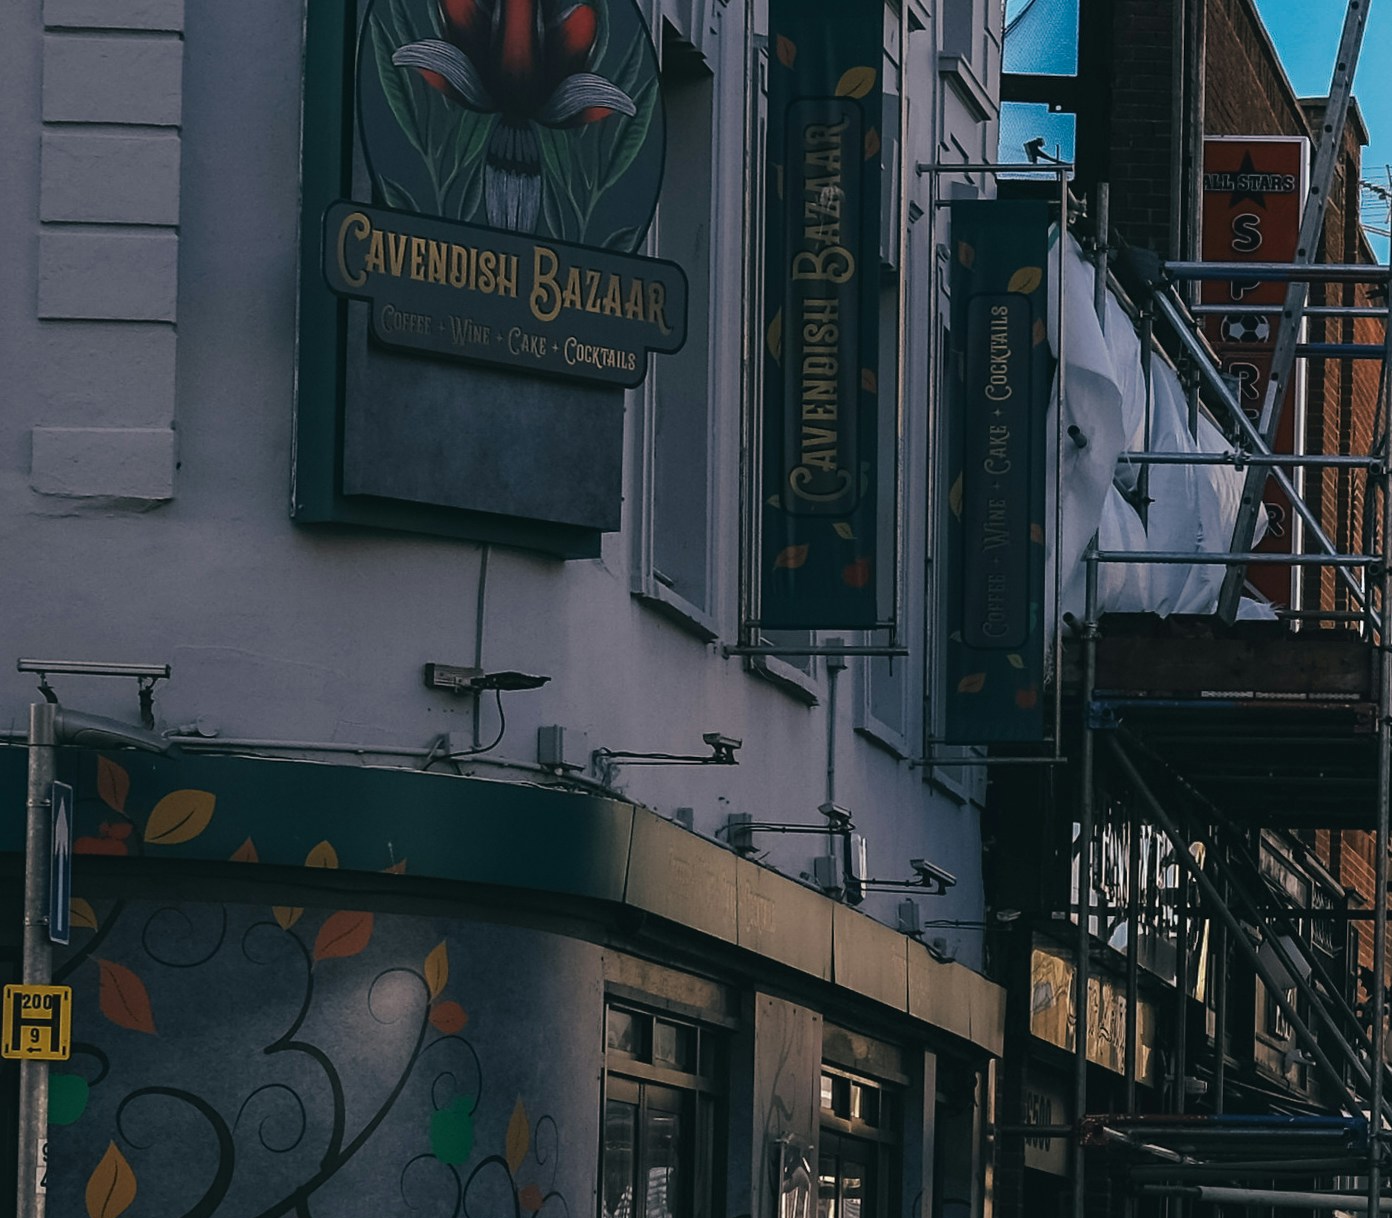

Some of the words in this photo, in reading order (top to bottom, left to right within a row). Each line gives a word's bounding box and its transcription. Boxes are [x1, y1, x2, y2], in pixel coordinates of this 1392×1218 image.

[1203, 173, 1235, 192] ALL
[1237, 173, 1296, 192] STARS
[22, 993, 53, 1010] 200
[30, 1027, 40, 1043] 9
